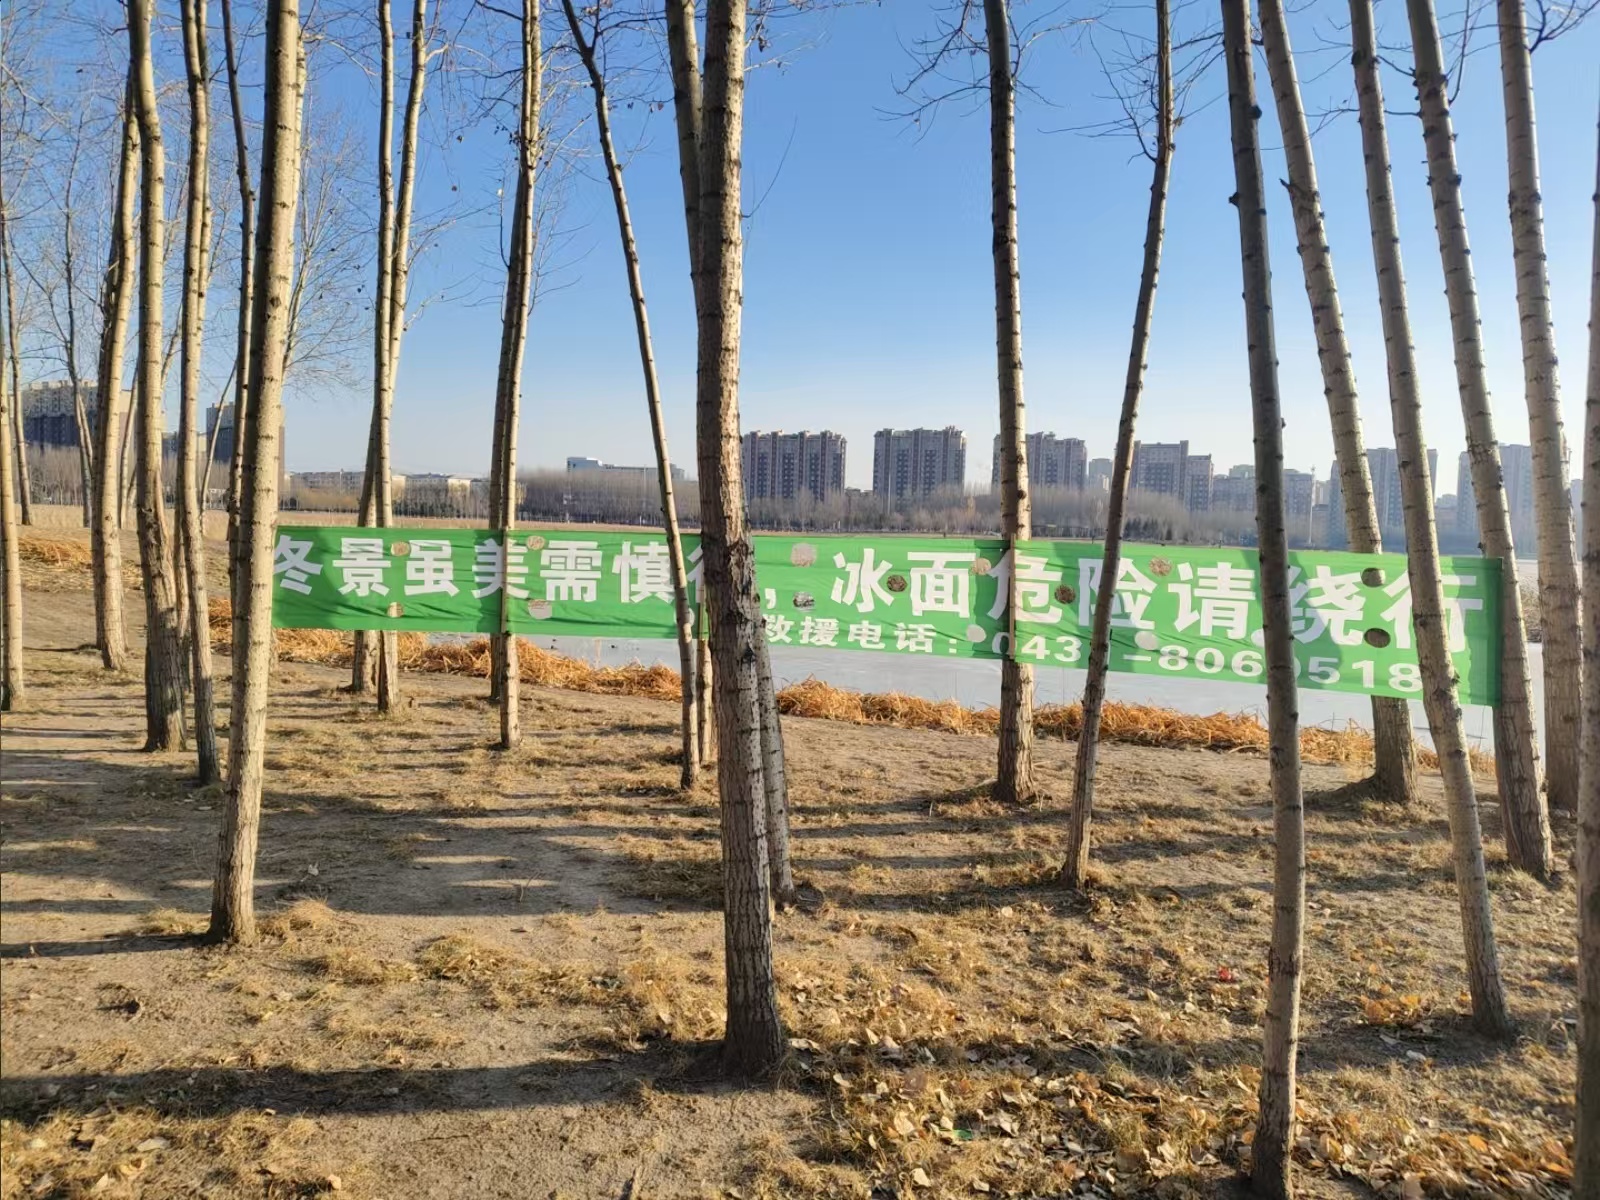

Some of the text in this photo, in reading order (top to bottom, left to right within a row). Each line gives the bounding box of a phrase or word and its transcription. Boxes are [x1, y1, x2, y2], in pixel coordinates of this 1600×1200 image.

[273, 534, 1484, 653] 冬景虽美需慎，冰面危险请绕行
